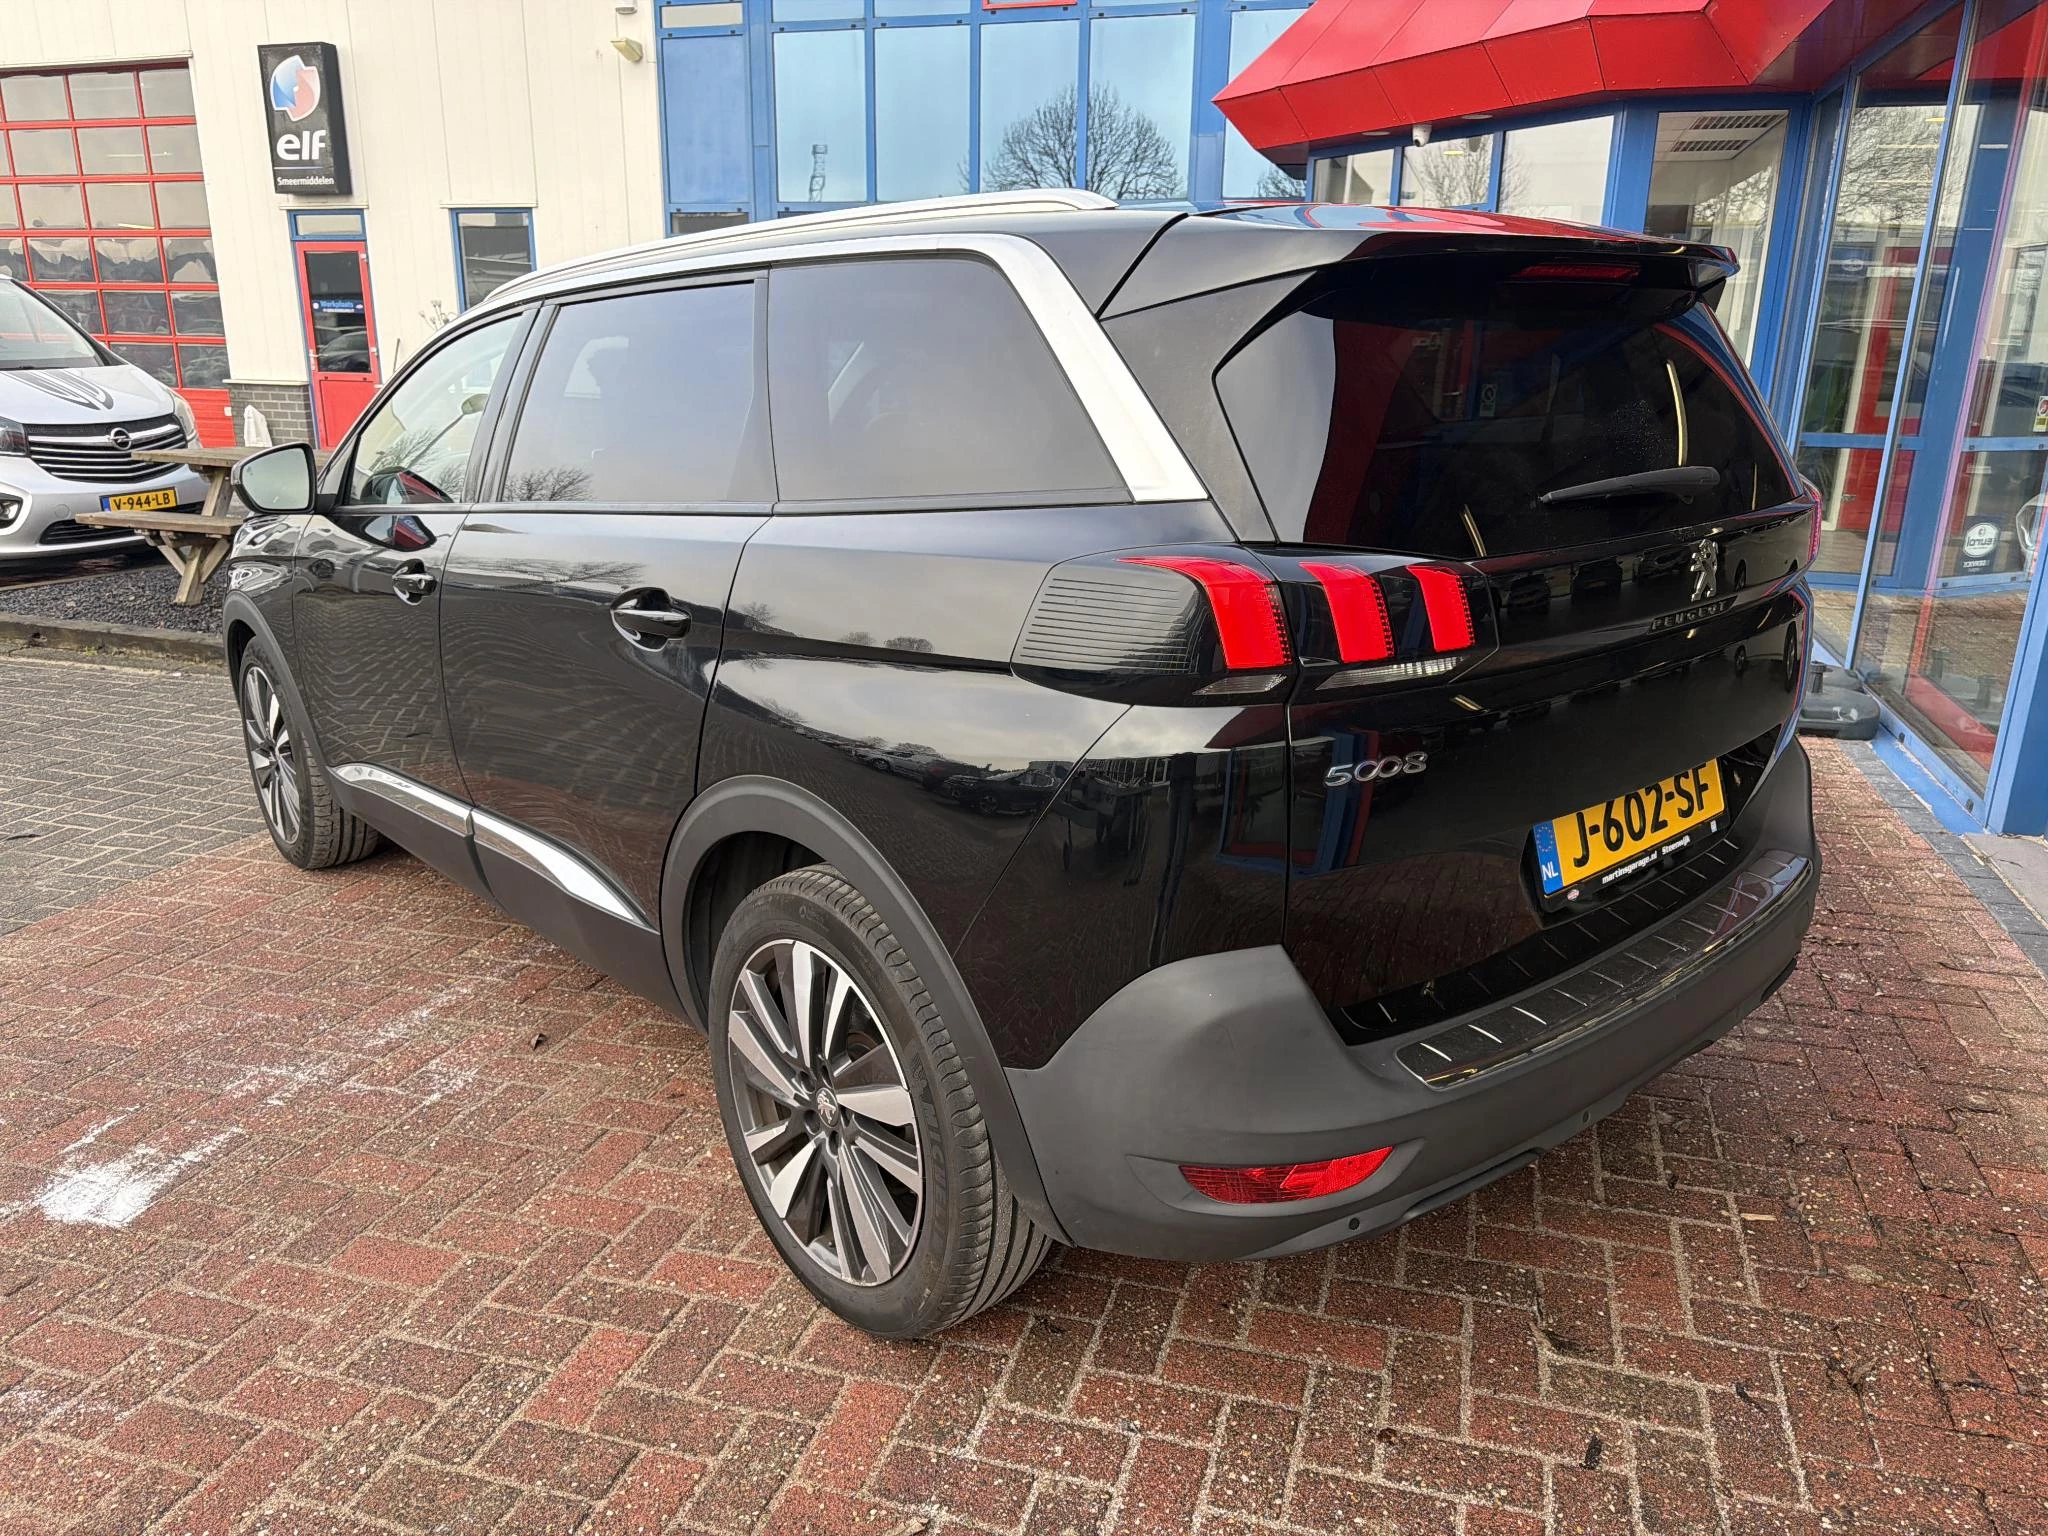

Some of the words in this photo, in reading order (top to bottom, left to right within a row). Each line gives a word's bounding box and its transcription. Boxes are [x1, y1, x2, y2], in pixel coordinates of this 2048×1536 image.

[276, 129, 327, 161] elf
[277, 176, 335, 187] Smeermiddelen
[113, 492, 171, 511] V-944-LB
[1651, 601, 1728, 630] PEUGEOT
[1323, 750, 1429, 787] 5008
[1573, 762, 1710, 869] J-602-SF
[1541, 861, 1559, 882] NL
[1602, 850, 1658, 884] martinsgarage.nl
[1661, 834, 1691, 855] Steenwijk
